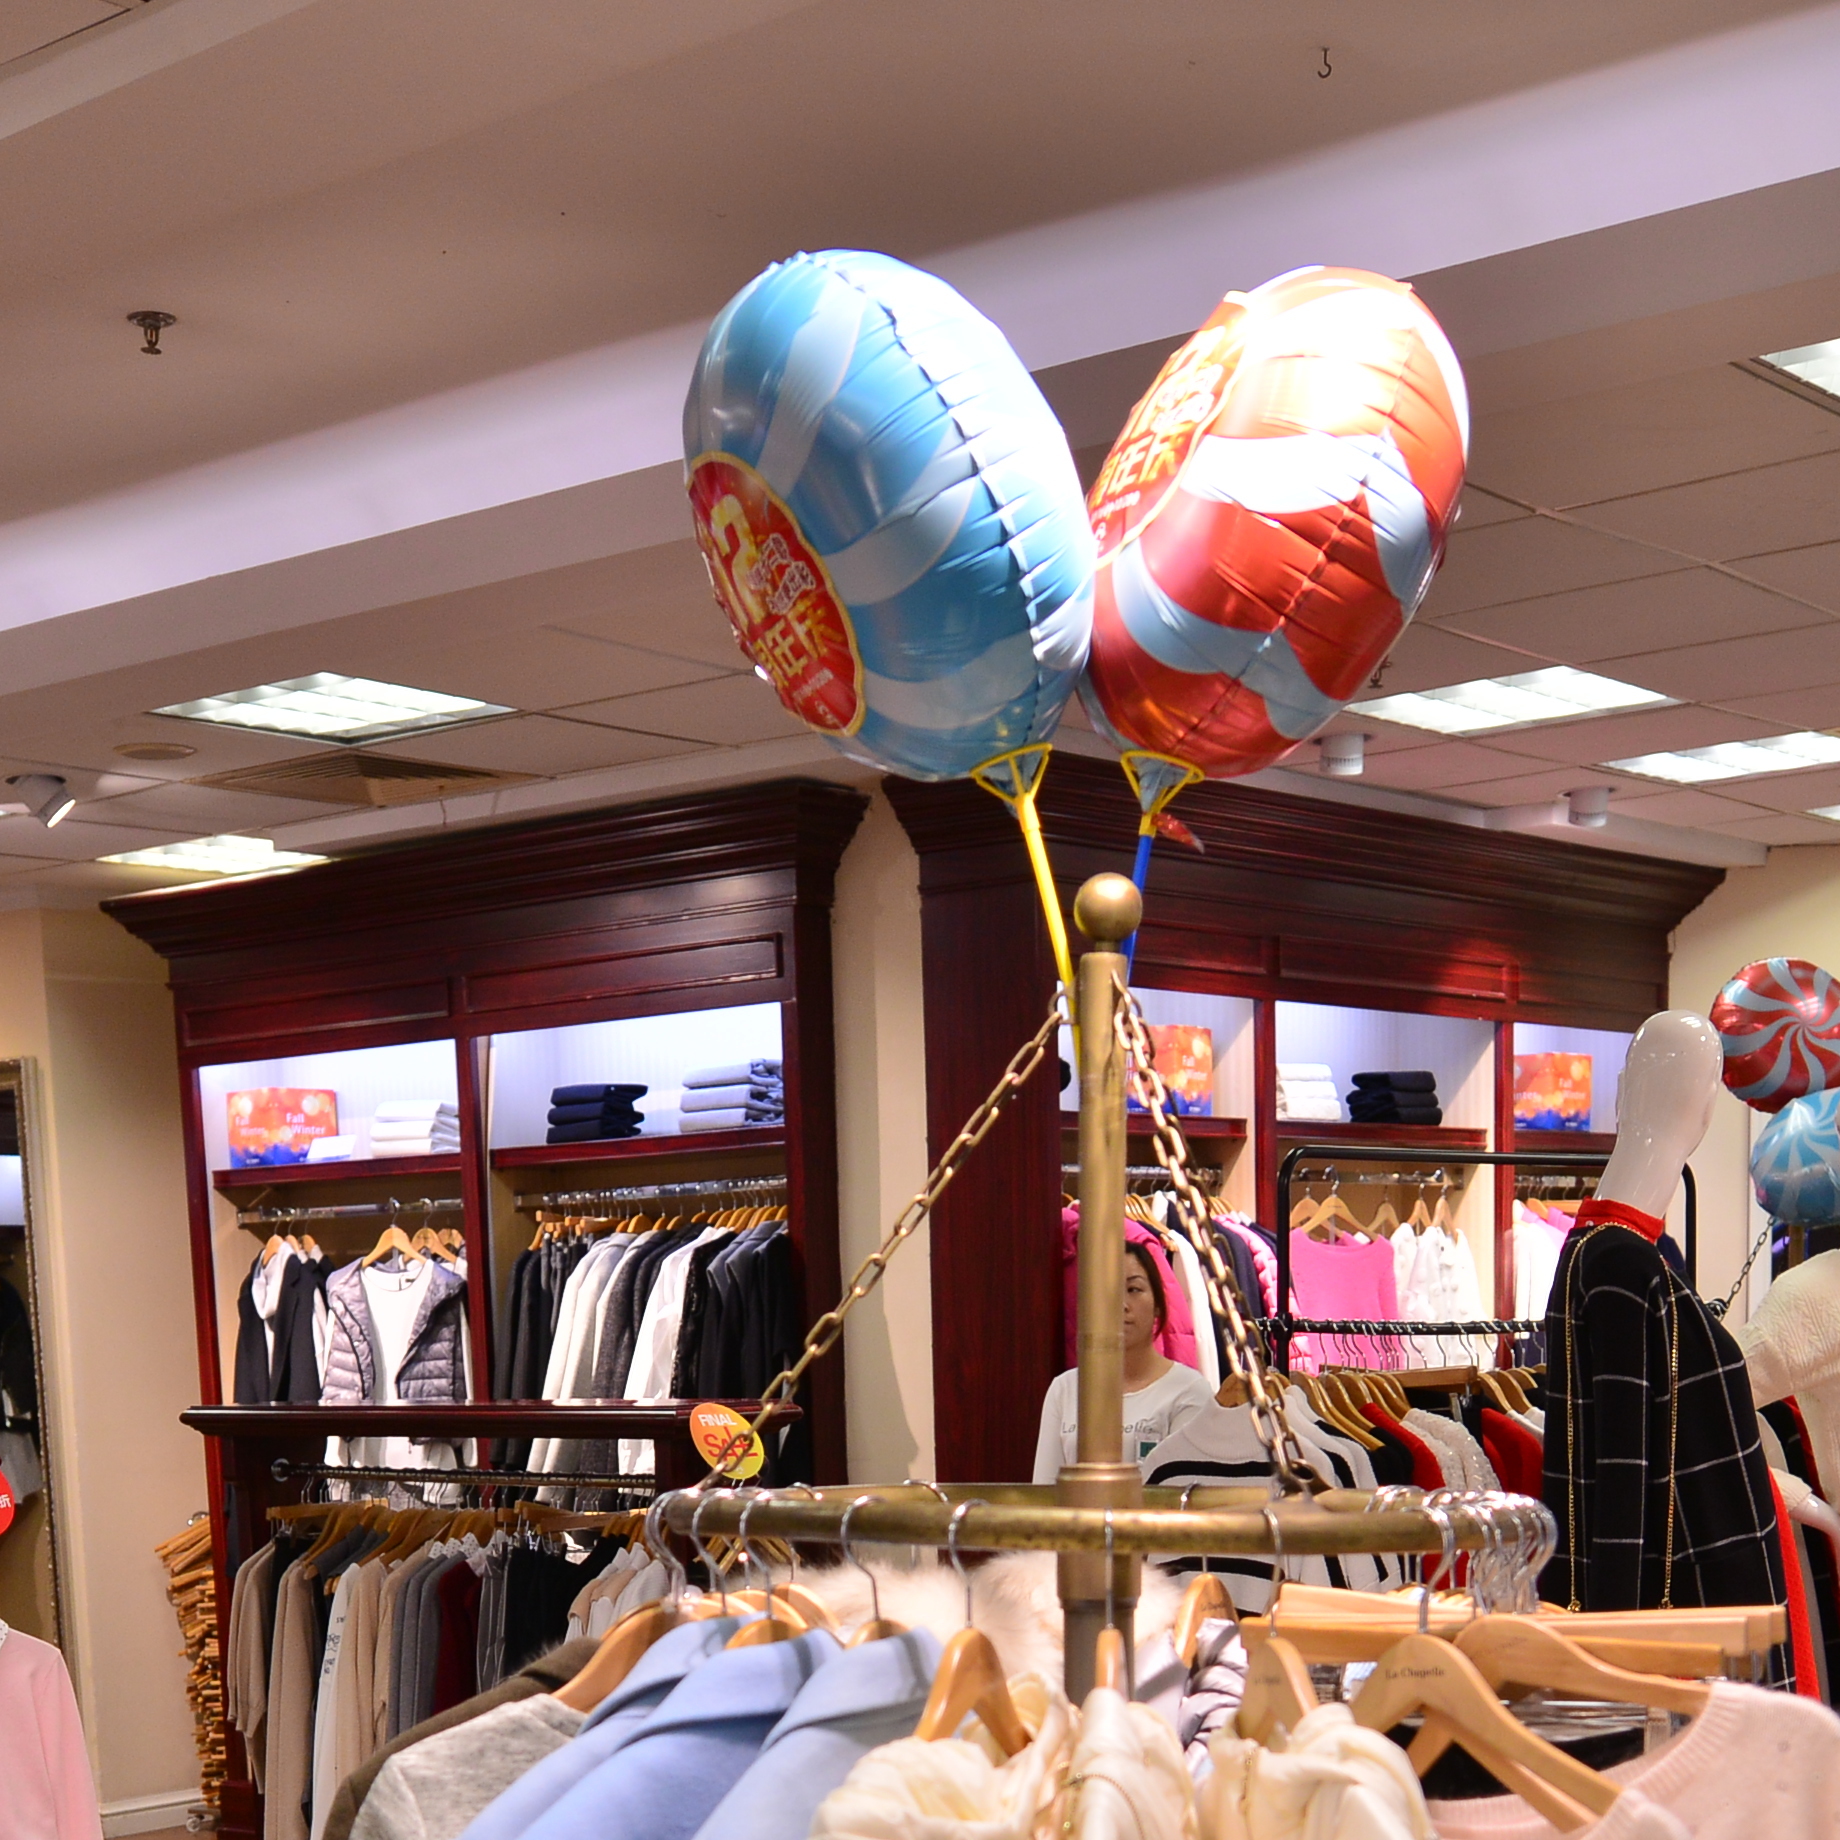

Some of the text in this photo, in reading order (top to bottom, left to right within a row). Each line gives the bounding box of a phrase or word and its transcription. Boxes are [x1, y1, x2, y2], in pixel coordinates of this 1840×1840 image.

[285, 1113, 305, 1123] Fall
[291, 1125, 326, 1135] Winter
[698, 1413, 737, 1427] FINAL
[1062, 1422, 1077, 1434] La
